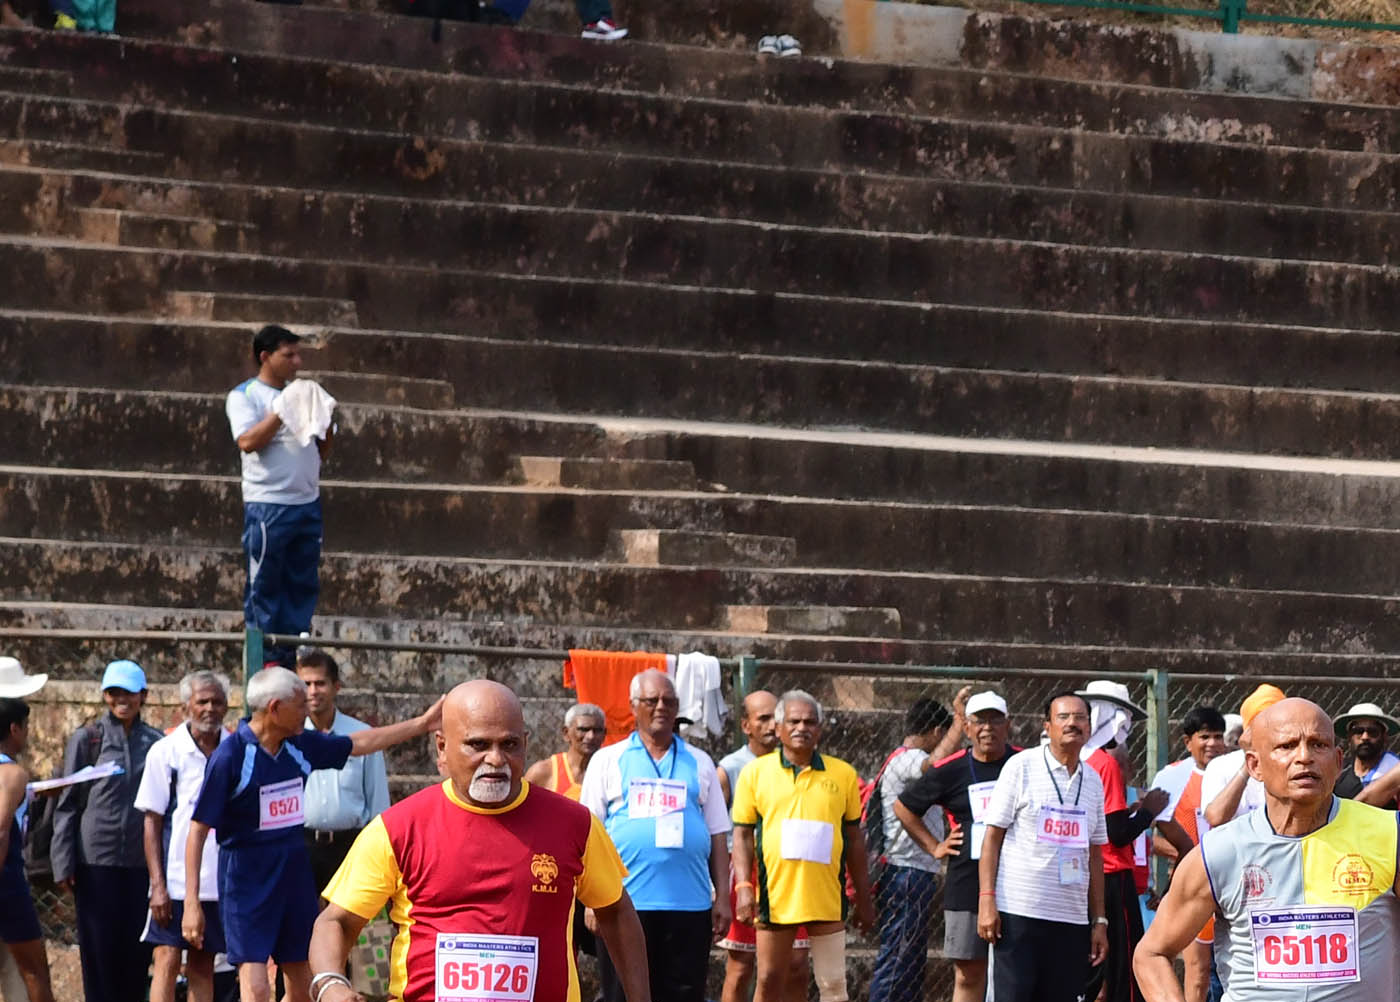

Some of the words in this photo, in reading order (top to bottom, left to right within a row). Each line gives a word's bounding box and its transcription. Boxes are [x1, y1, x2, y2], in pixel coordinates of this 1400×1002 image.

[1044, 818, 1079, 837] 6530
[1263, 933, 1348, 965] 65118
[443, 961, 529, 993] 65126
